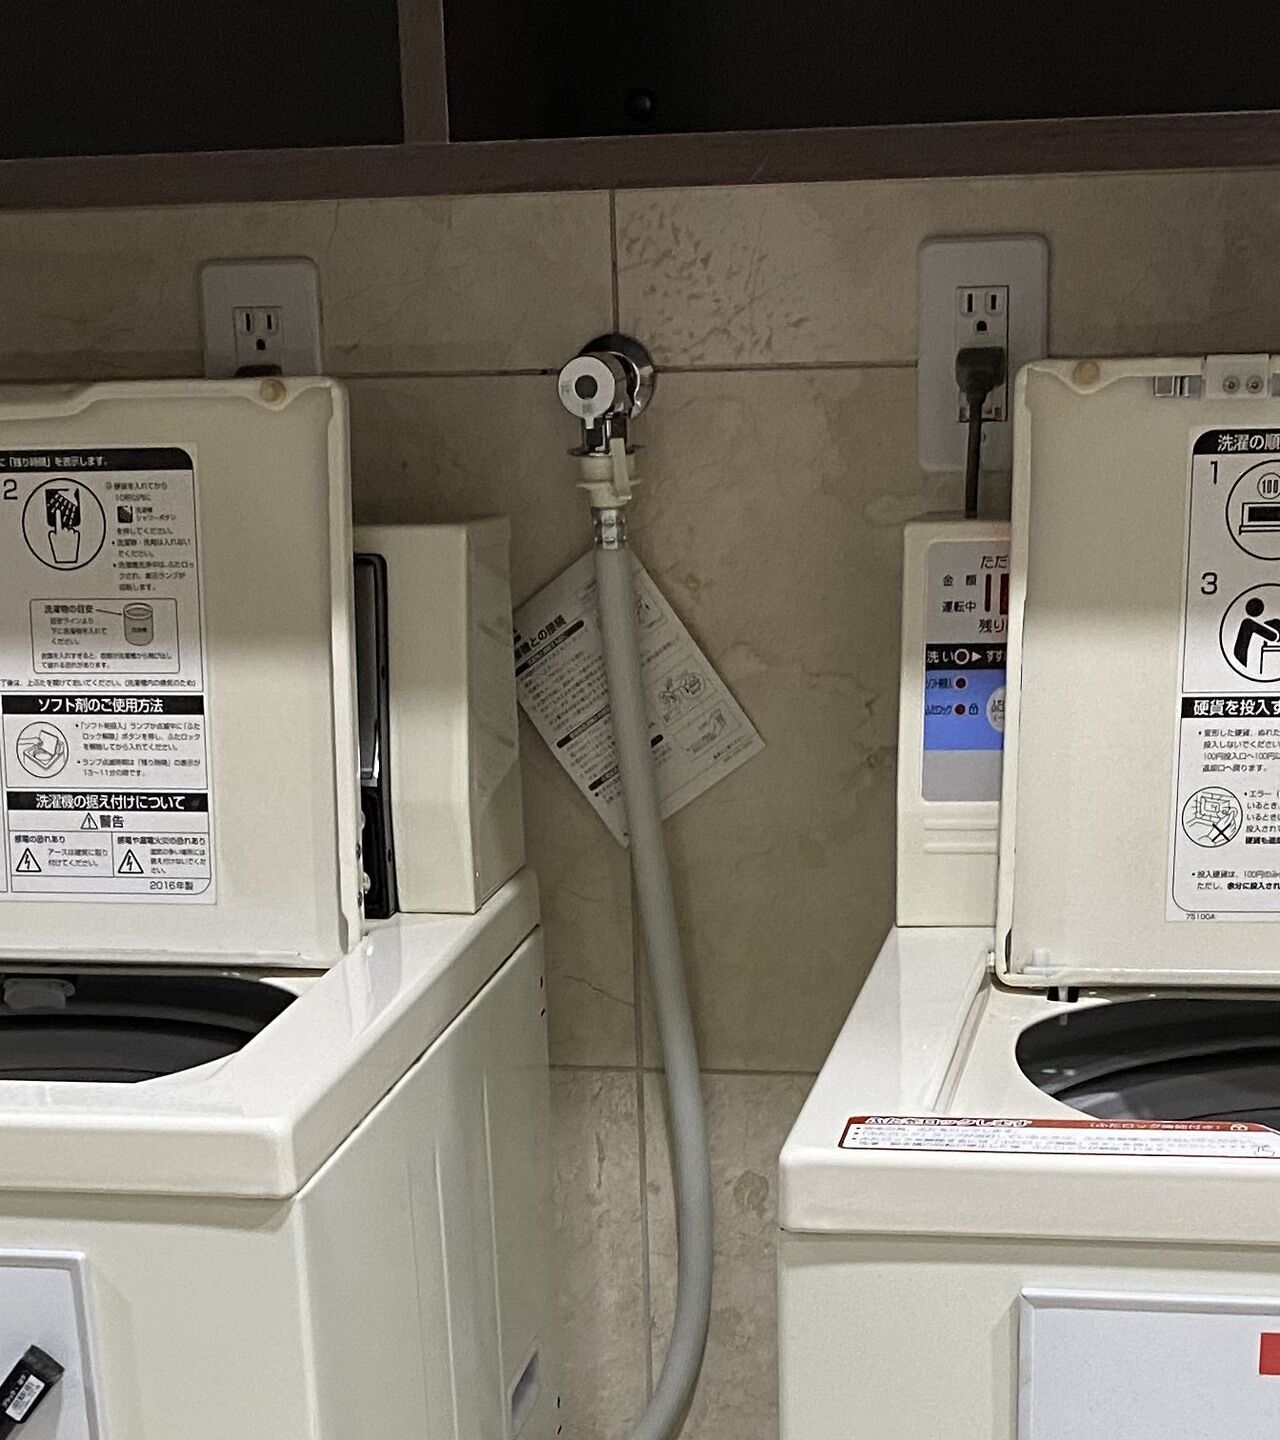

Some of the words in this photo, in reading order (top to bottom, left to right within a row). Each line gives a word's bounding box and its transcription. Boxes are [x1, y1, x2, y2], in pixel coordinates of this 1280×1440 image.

[1210, 460, 1219, 485] 1
[3, 478, 18, 500] 2
[1200, 571, 1218, 596] 3
[978, 619, 1009, 634] 残り
[38, 697, 164, 713] ソフト剤のご使用方法
[35, 793, 186, 809] 洗濯機の据え付けについて
[99, 814, 125, 829] 警告
